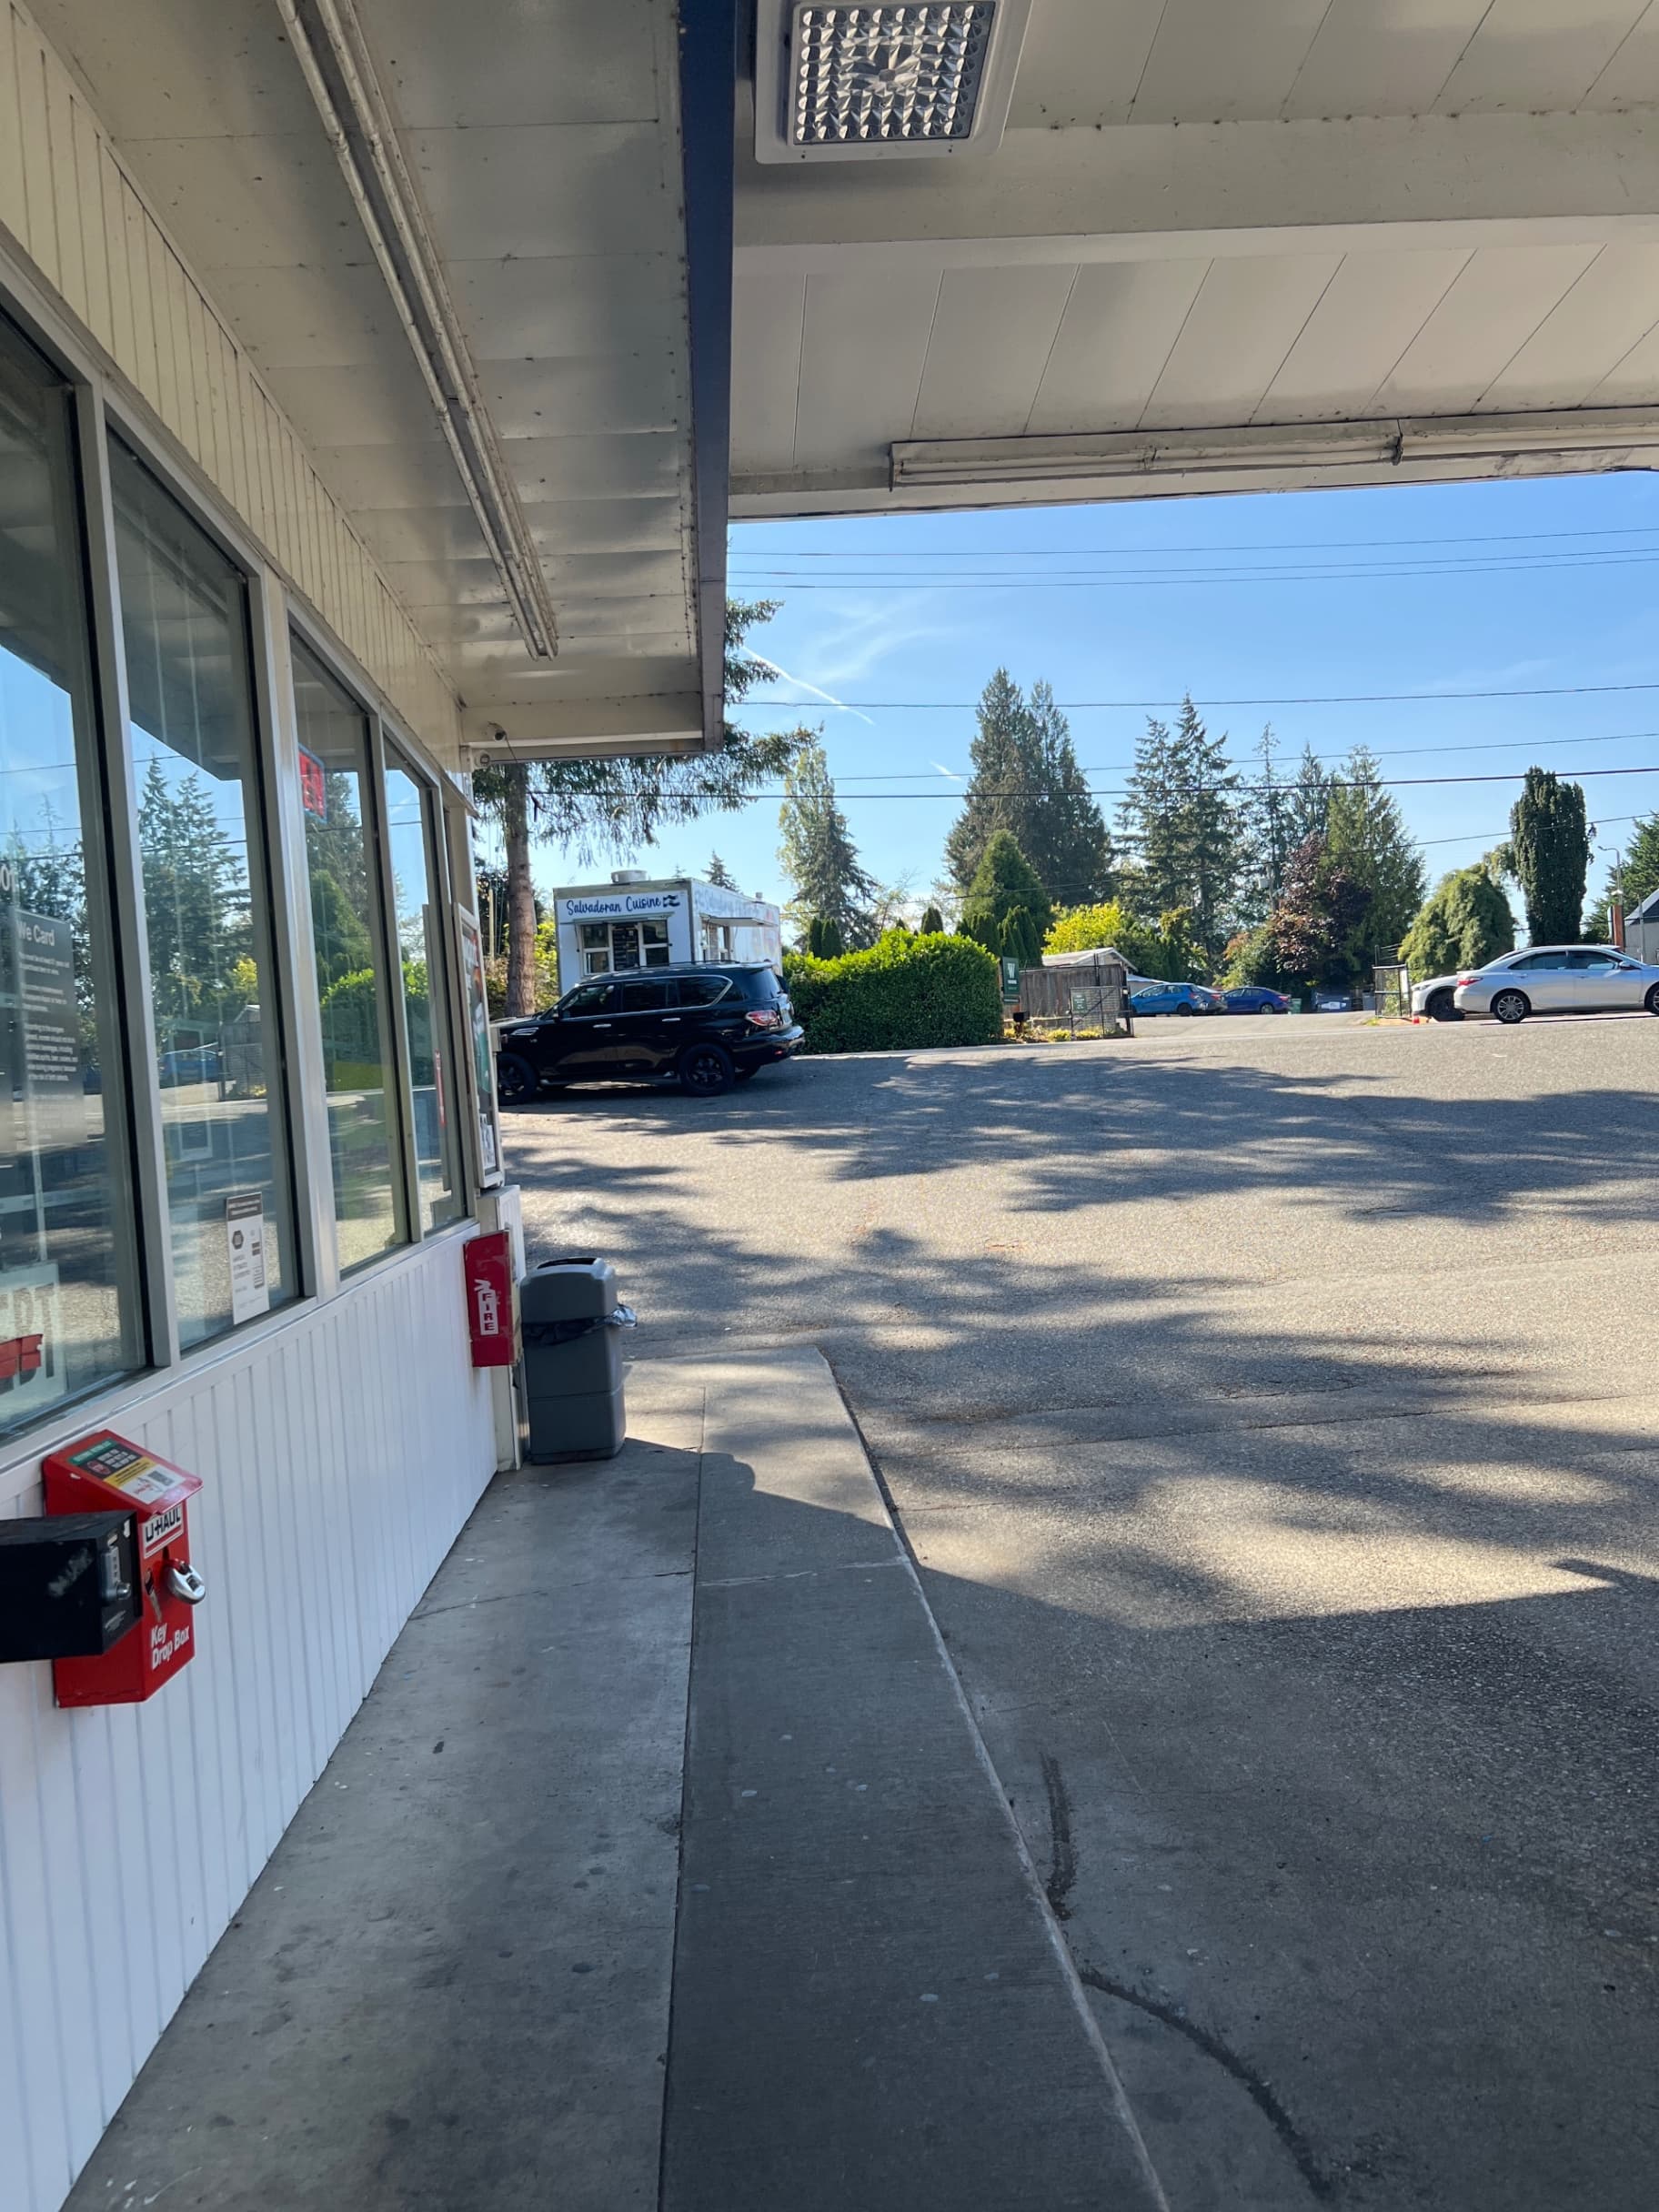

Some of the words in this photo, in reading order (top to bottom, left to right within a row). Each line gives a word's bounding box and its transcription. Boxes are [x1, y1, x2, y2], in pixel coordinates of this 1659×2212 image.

[567, 900, 621, 916] Salvadoran
[626, 896, 661, 911] Cuisine
[18, 920, 33, 941] We
[33, 924, 55, 946] Card
[482, 1292, 495, 1332] FIRE
[146, 1507, 181, 1543] U-HAUL
[151, 1623, 167, 1648] Key
[152, 1640, 174, 1670] Drop
[174, 1625, 189, 1652] Box
